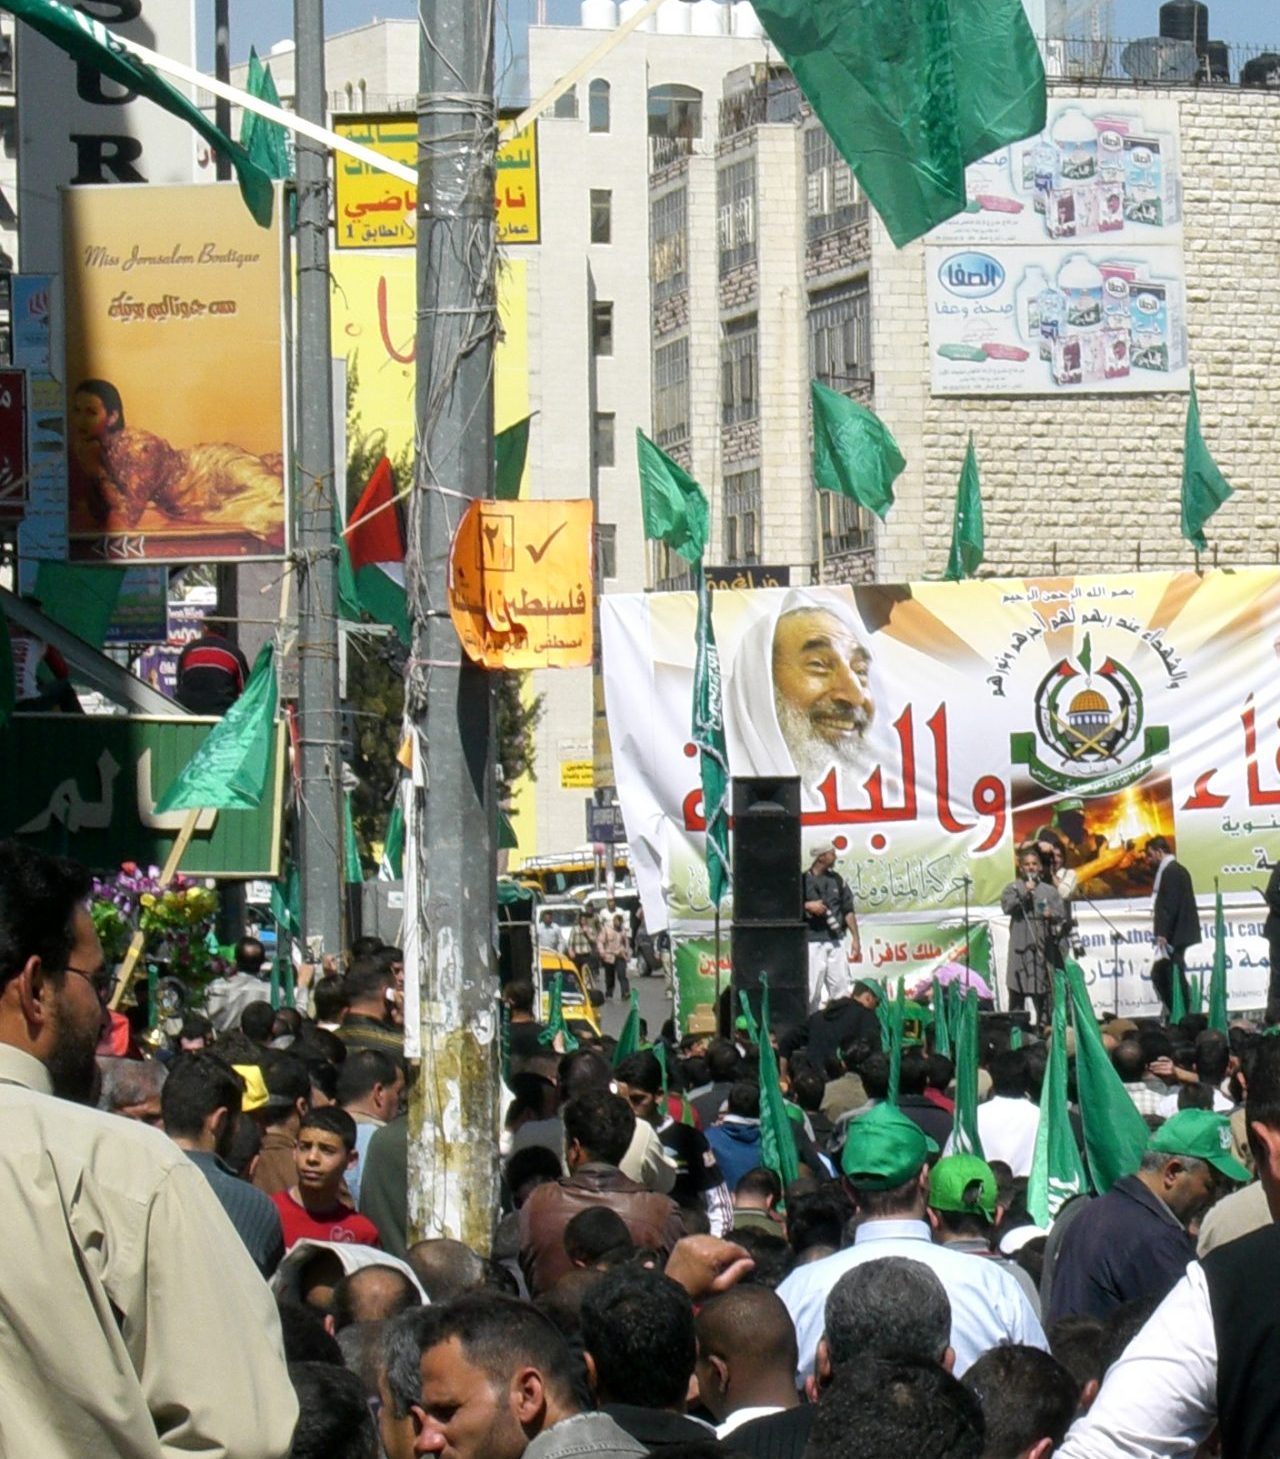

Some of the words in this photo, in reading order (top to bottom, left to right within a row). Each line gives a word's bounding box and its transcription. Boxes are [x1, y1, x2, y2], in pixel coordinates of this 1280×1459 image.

[85, 246, 120, 267] Miss
[198, 243, 260, 268] Boutique
[947, 263, 996, 288] الصفا
[1003, 589, 1039, 603] الرحيم
[1042, 587, 1082, 600] الرحمن
[1086, 586, 1106, 598] الله
[1111, 588, 1135, 598] بسم
[1051, 607, 1076, 631] لهم
[1081, 608, 1113, 629] ربهم
[1115, 617, 1141, 634] عند
[1127, 927, 1154, 945] the
